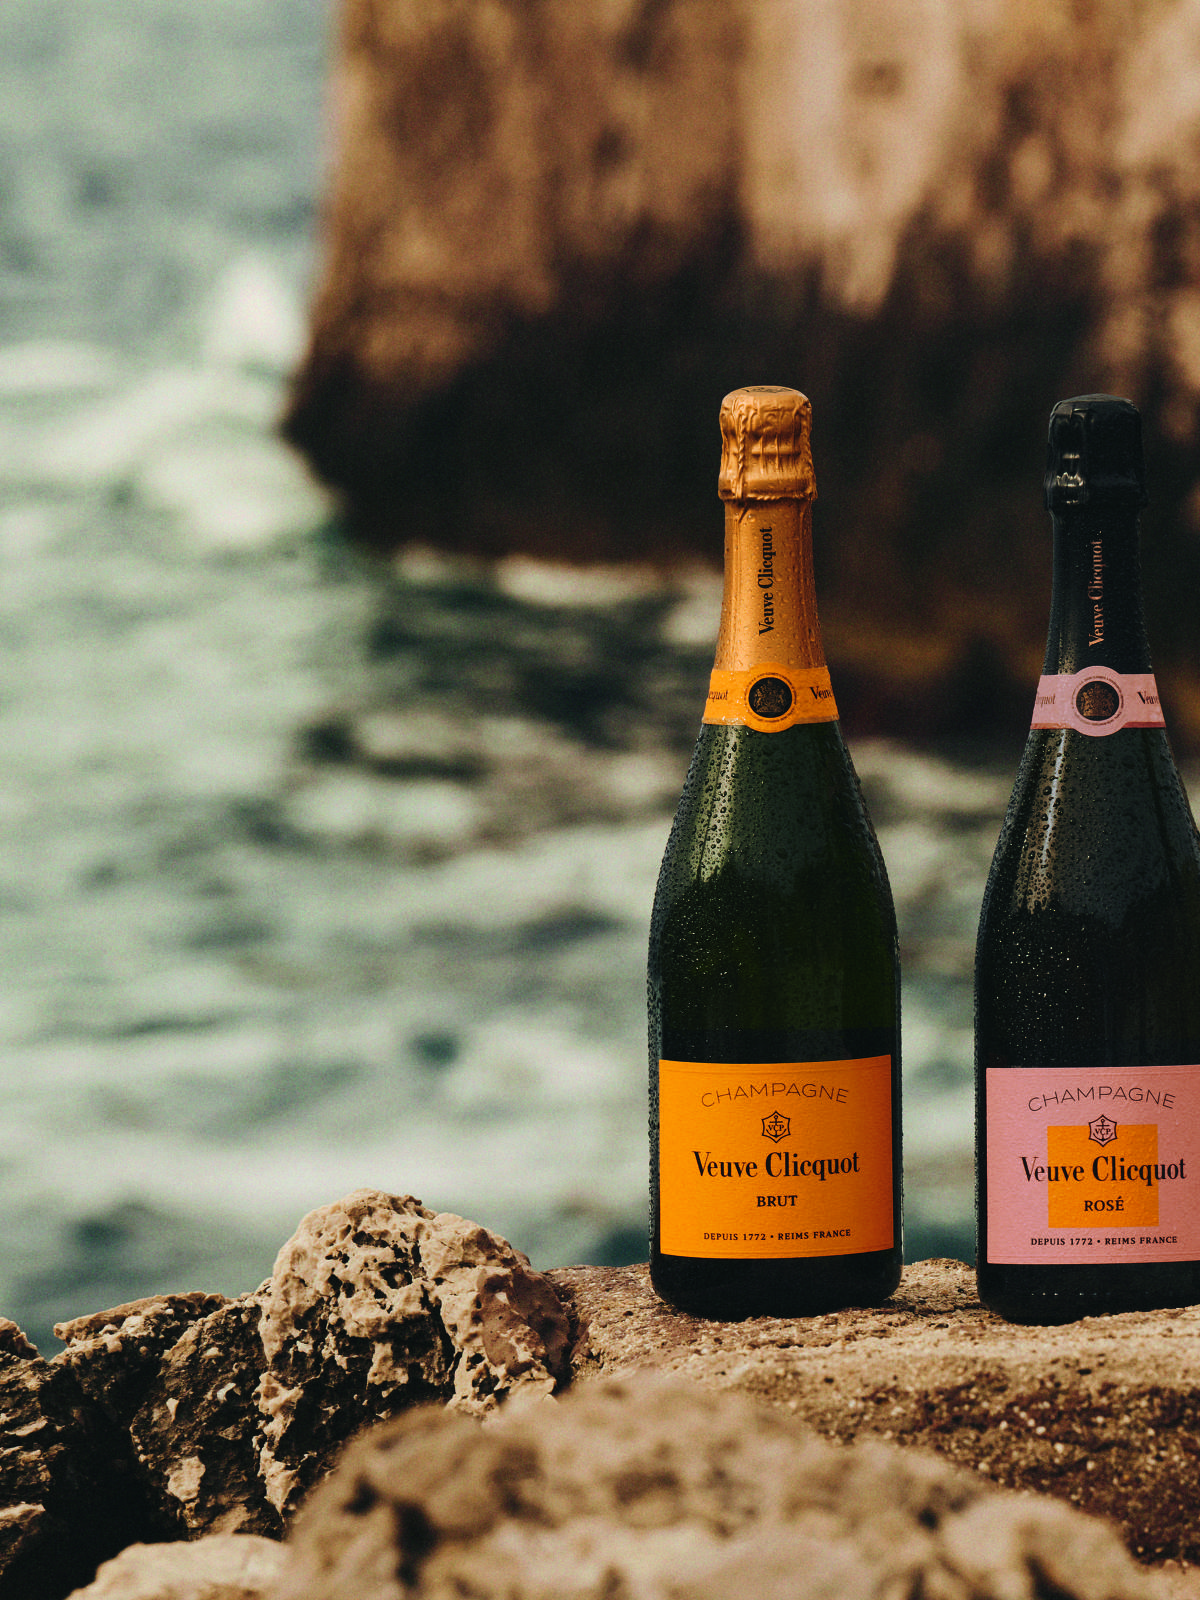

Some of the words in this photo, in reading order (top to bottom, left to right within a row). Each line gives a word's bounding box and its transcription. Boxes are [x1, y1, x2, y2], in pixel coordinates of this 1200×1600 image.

[757, 526, 777, 589] Clicquot
[1087, 538, 1107, 601] Clicquot
[758, 592, 775, 636] Veuve
[1088, 603, 1105, 647] Veuve
[701, 1082, 849, 1108] CHAMPAGNE
[1028, 1086, 1176, 1112] CHAMPAGNE
[692, 1150, 758, 1178] Veuve
[765, 1151, 860, 1181] Clicquot
[1019, 1156, 1085, 1182] Veuve
[1092, 1155, 1187, 1186] Clicquot
[756, 1195, 798, 1207] BRUT
[1084, 1196, 1125, 1212] ROSÉ
[703, 1232, 738, 1241] DEPUIS
[743, 1233, 766, 1241] 1772
[777, 1231, 809, 1240] REIMS
[813, 1229, 851, 1239] FRANCE
[1030, 1237, 1066, 1246] DEPUIS
[1070, 1237, 1093, 1246] 1772
[1105, 1237, 1136, 1245] REIMS
[1140, 1236, 1177, 1245] FRANCE
